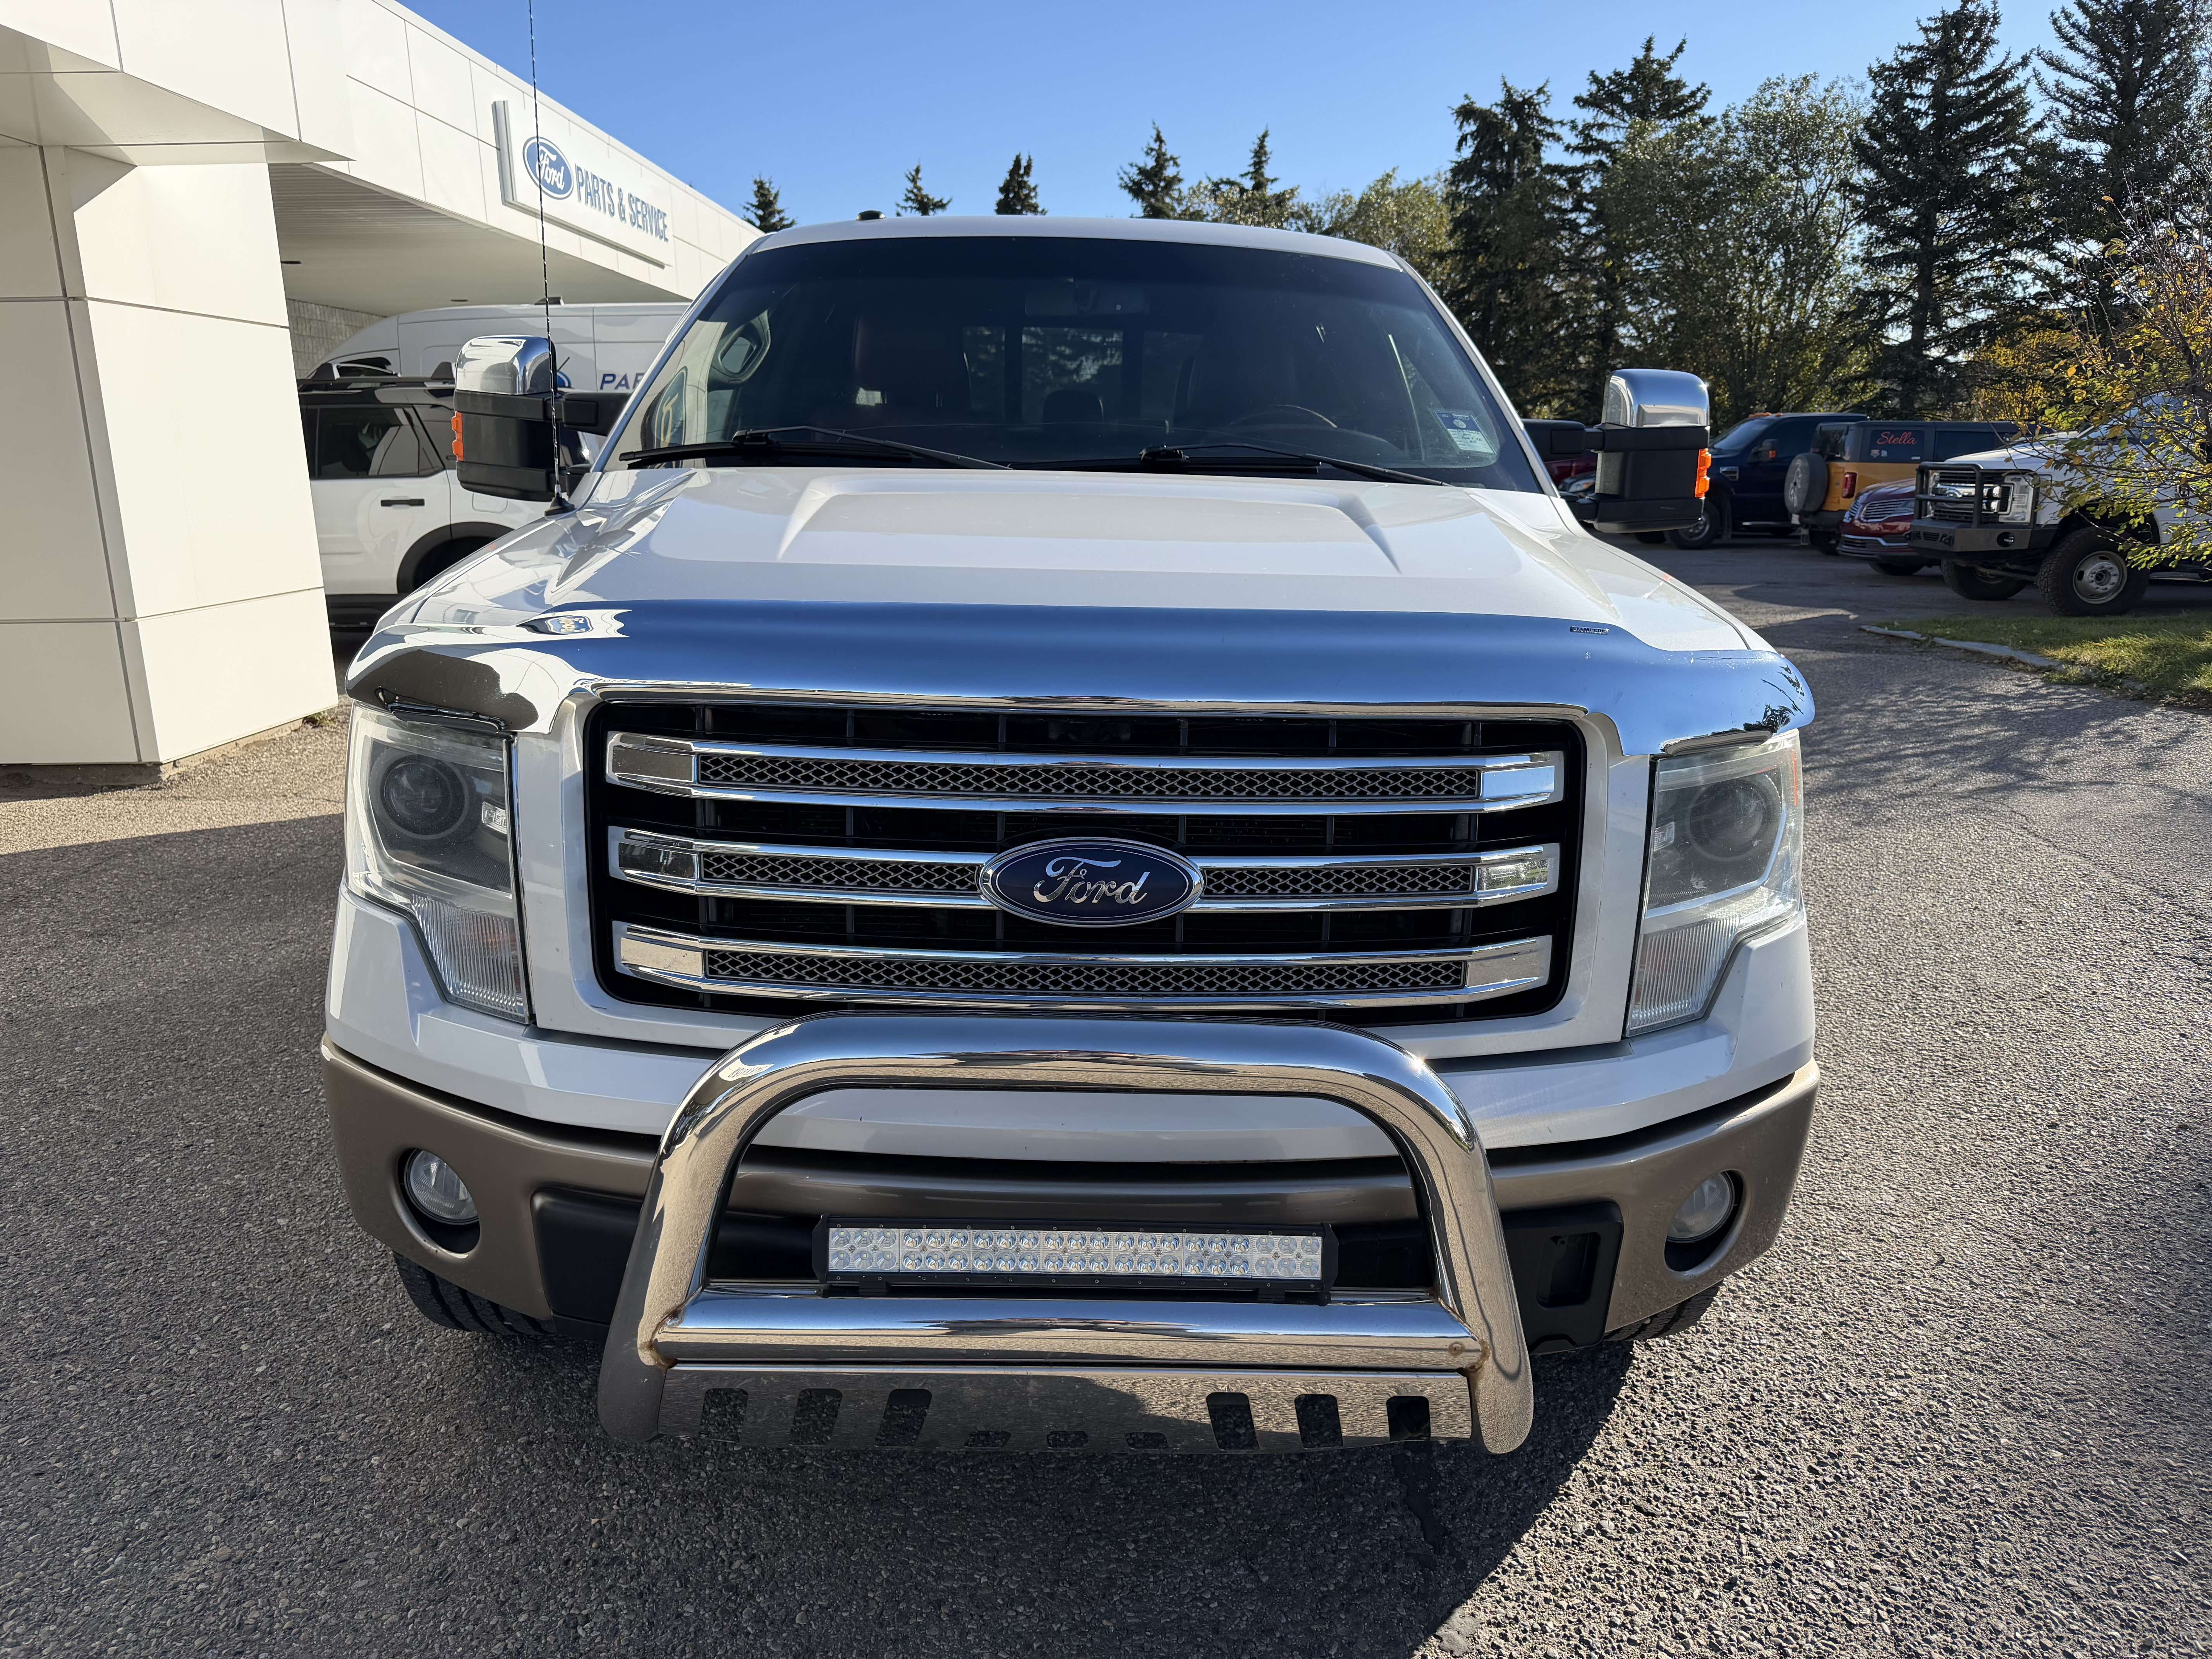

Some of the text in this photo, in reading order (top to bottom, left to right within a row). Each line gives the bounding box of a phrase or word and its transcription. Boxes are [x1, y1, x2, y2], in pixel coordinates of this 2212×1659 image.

[536, 146, 565, 190] Ford
[575, 164, 668, 242] PARTS & SERVICE
[1877, 431, 1917, 444] Stella
[1034, 857, 1150, 904] Ford
